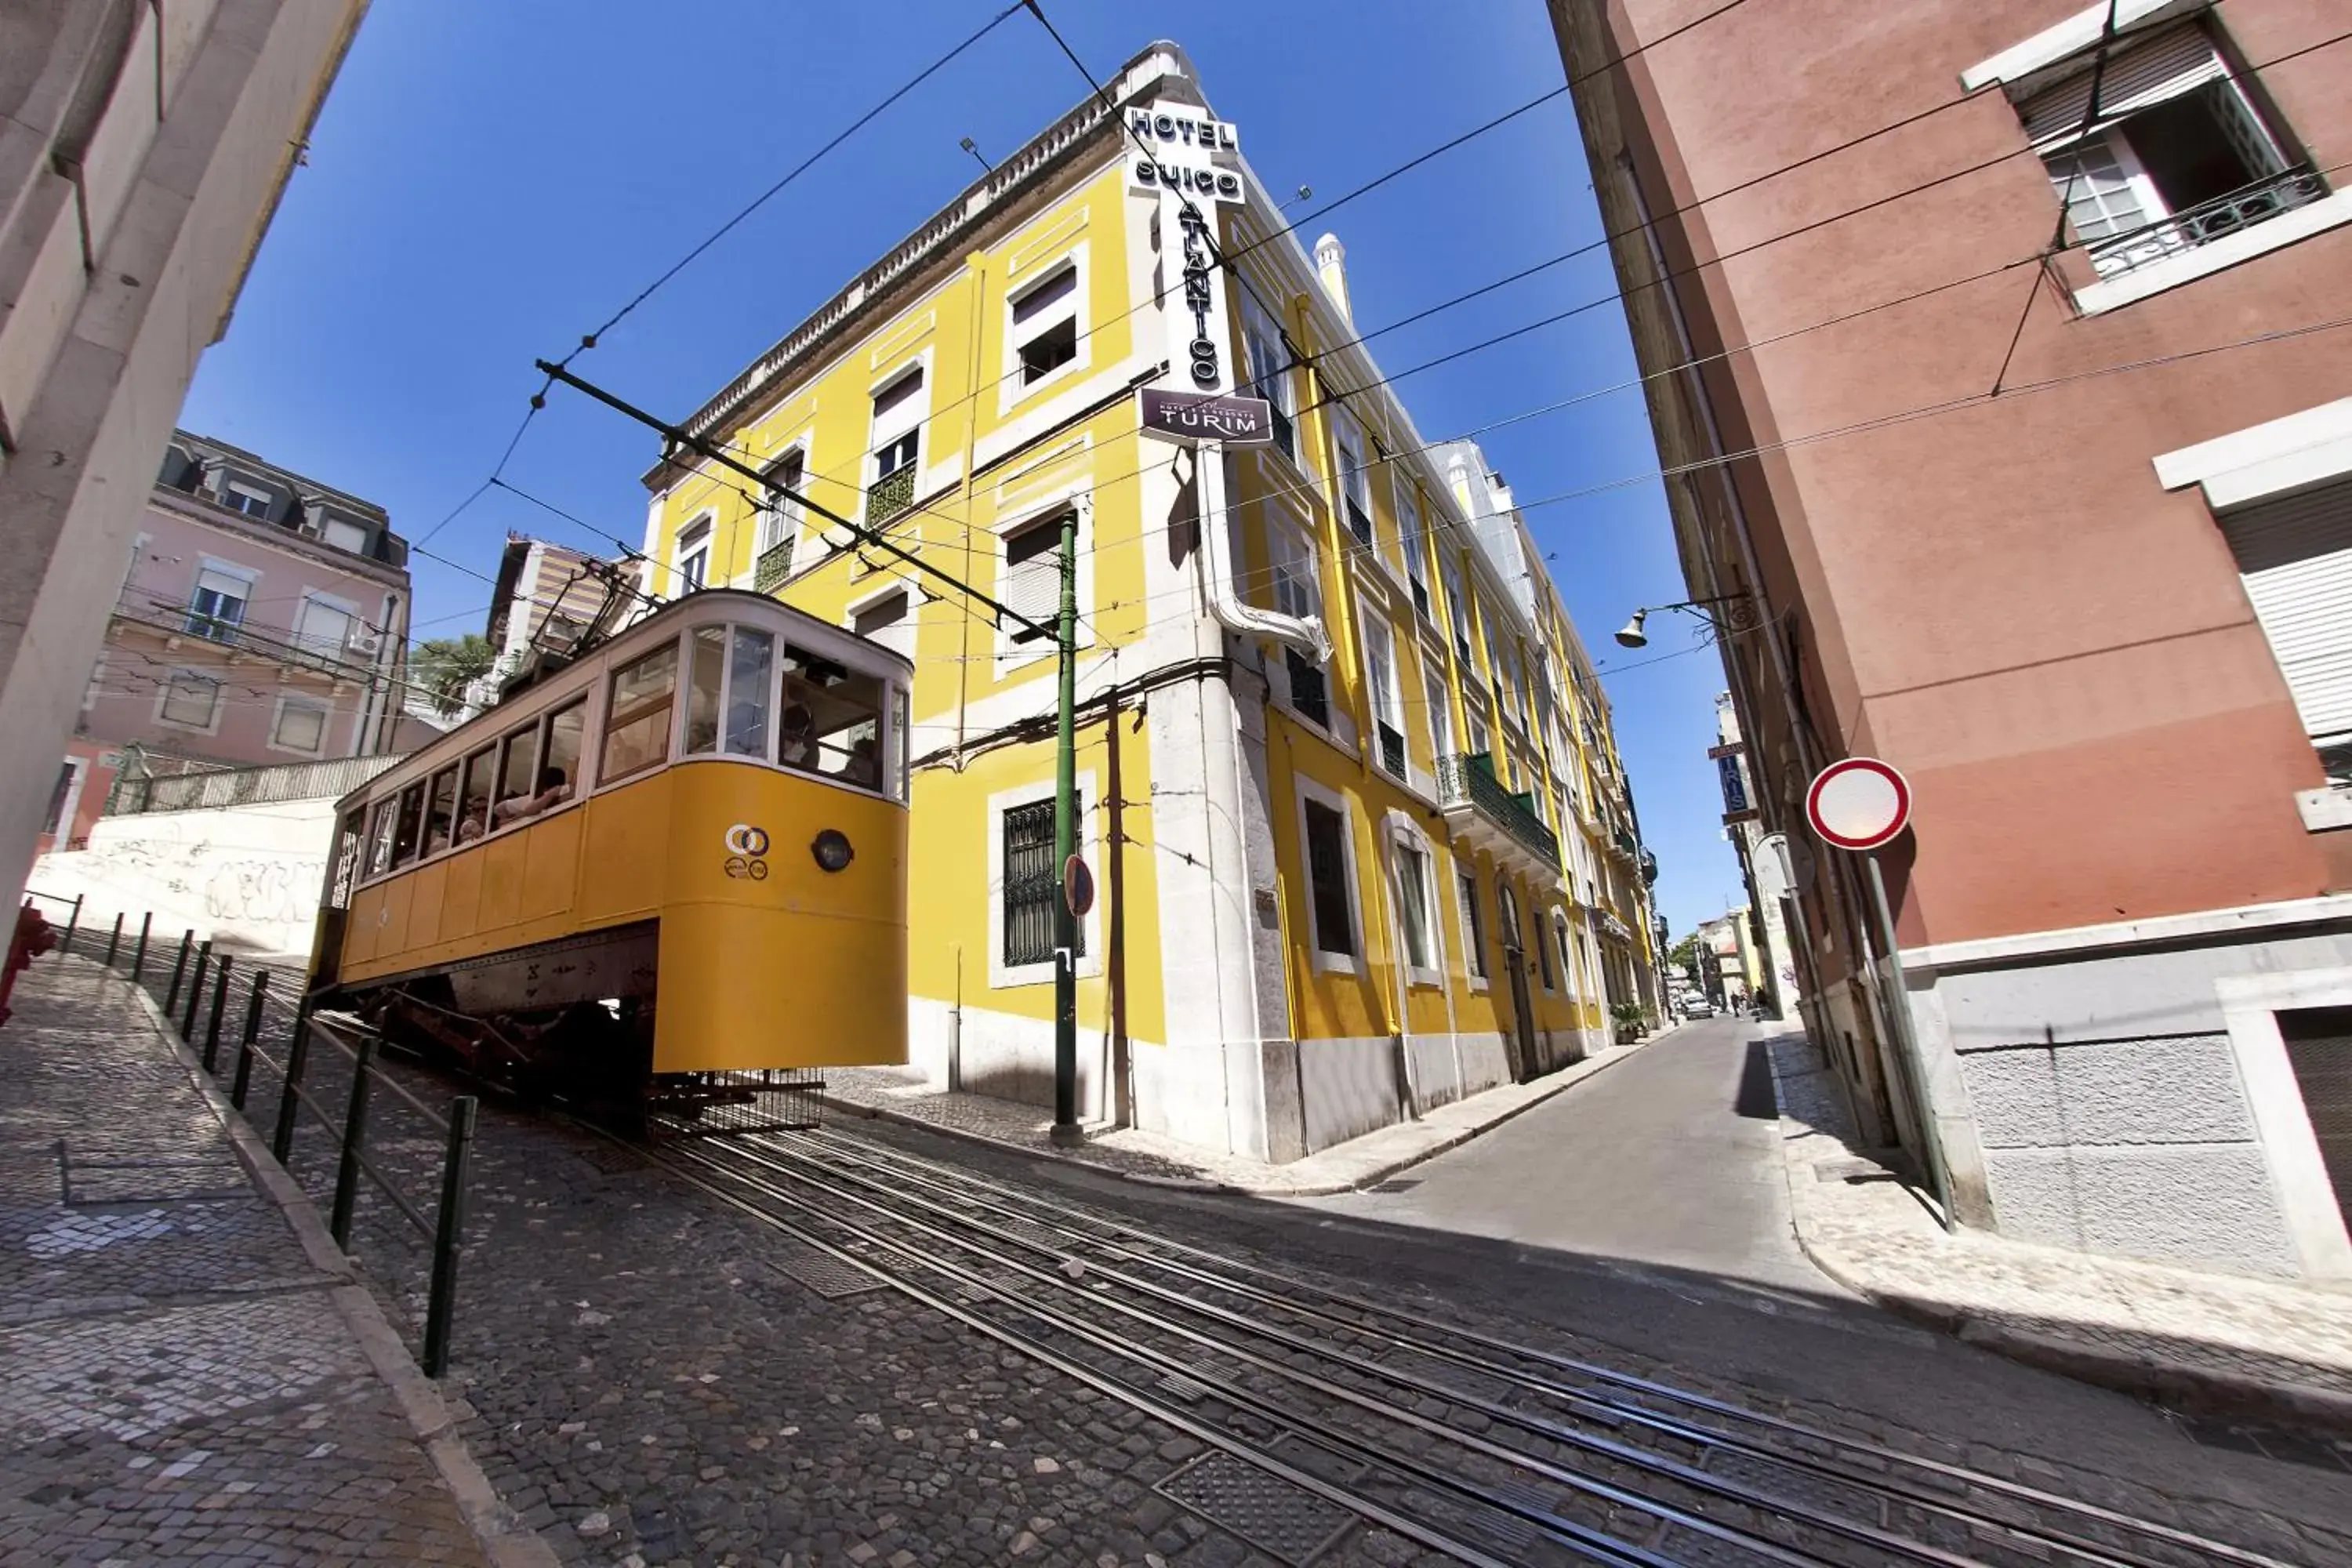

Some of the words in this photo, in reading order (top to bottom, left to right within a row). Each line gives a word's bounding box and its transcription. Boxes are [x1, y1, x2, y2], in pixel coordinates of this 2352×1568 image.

[1131, 110, 1235, 149] HOTEL
[1160, 410, 1255, 436] TURIM
[1725, 757, 1744, 808] IRIS
